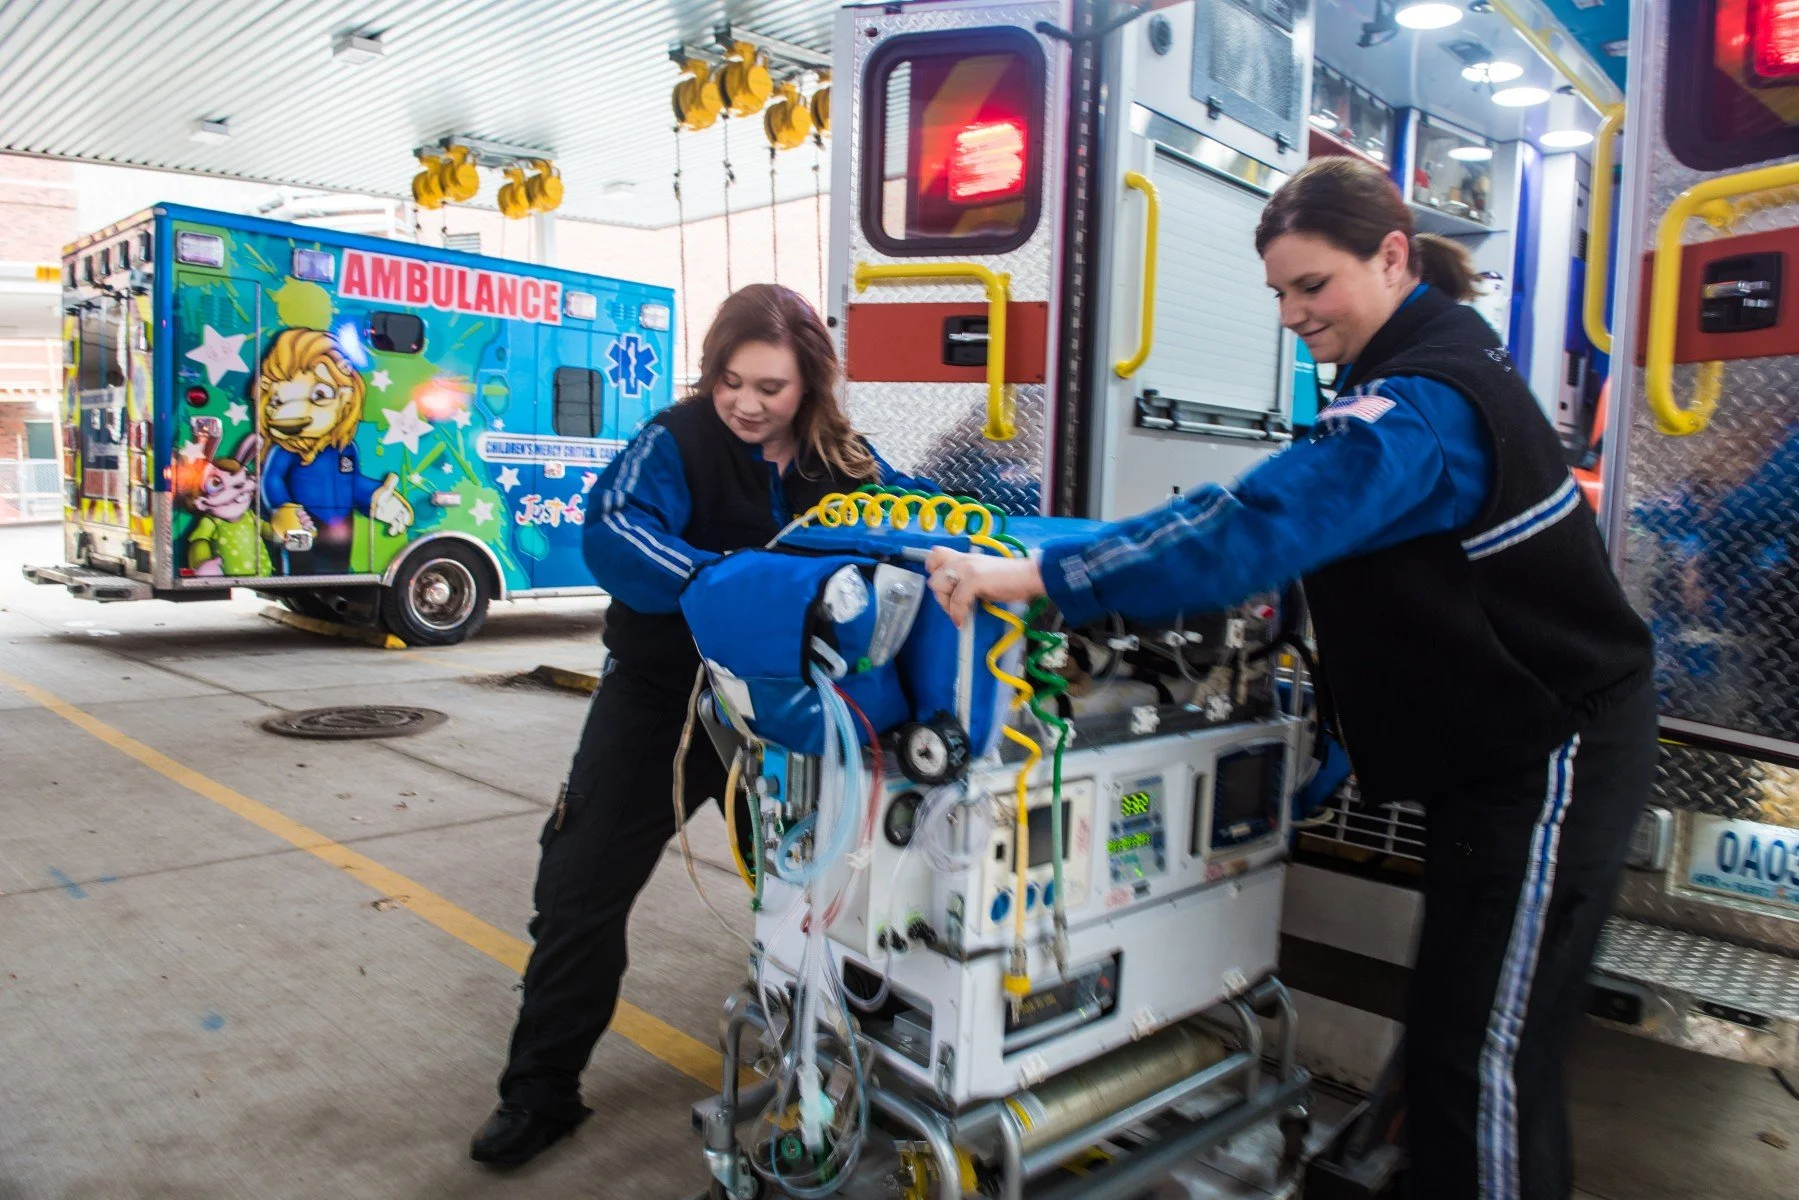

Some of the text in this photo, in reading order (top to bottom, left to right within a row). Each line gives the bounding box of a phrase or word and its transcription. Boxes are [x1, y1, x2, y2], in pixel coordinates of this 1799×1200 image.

[342, 252, 561, 323] AMBULANCE
[486, 441, 533, 455] CHILDREN'S
[534, 443, 561, 457] MERCY
[564, 445, 597, 459] CRITICAL
